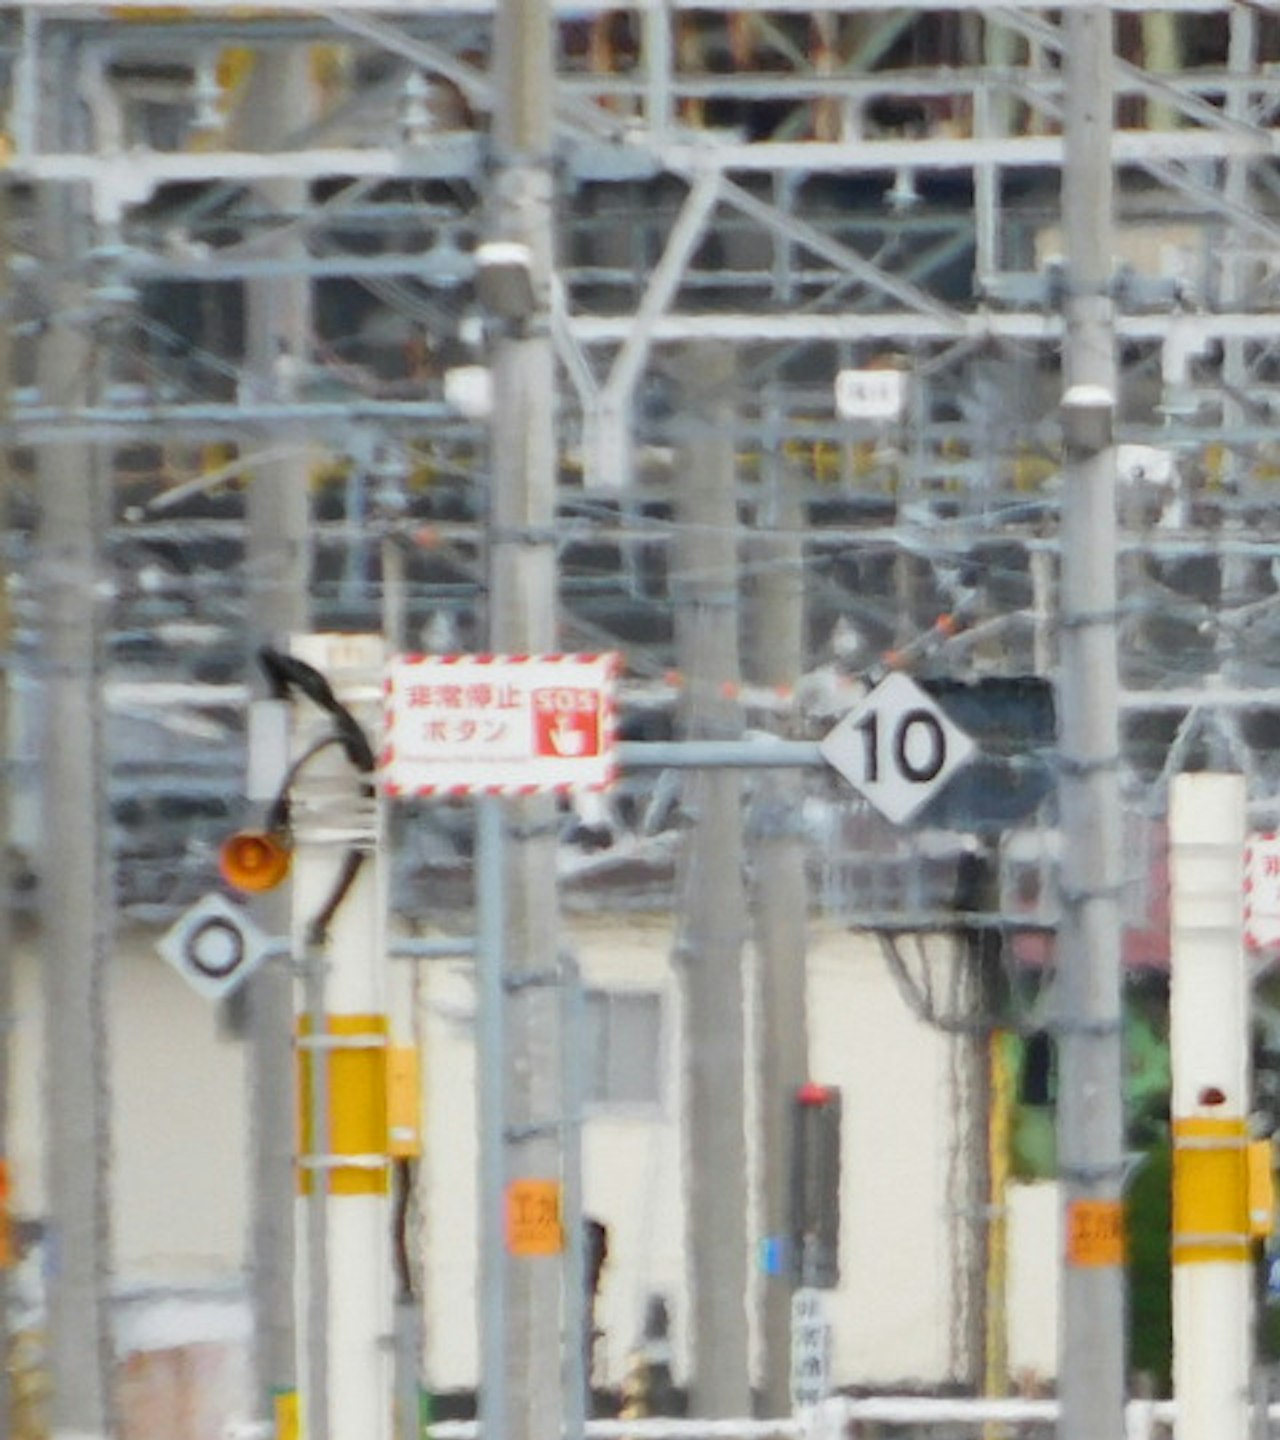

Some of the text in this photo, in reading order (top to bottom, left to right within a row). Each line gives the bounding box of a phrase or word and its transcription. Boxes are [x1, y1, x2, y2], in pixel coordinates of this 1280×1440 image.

[405, 684, 522, 709] 非常停止
[537, 689, 597, 713] SOS
[423, 718, 509, 743] ボタン
[853, 709, 946, 783] 10
